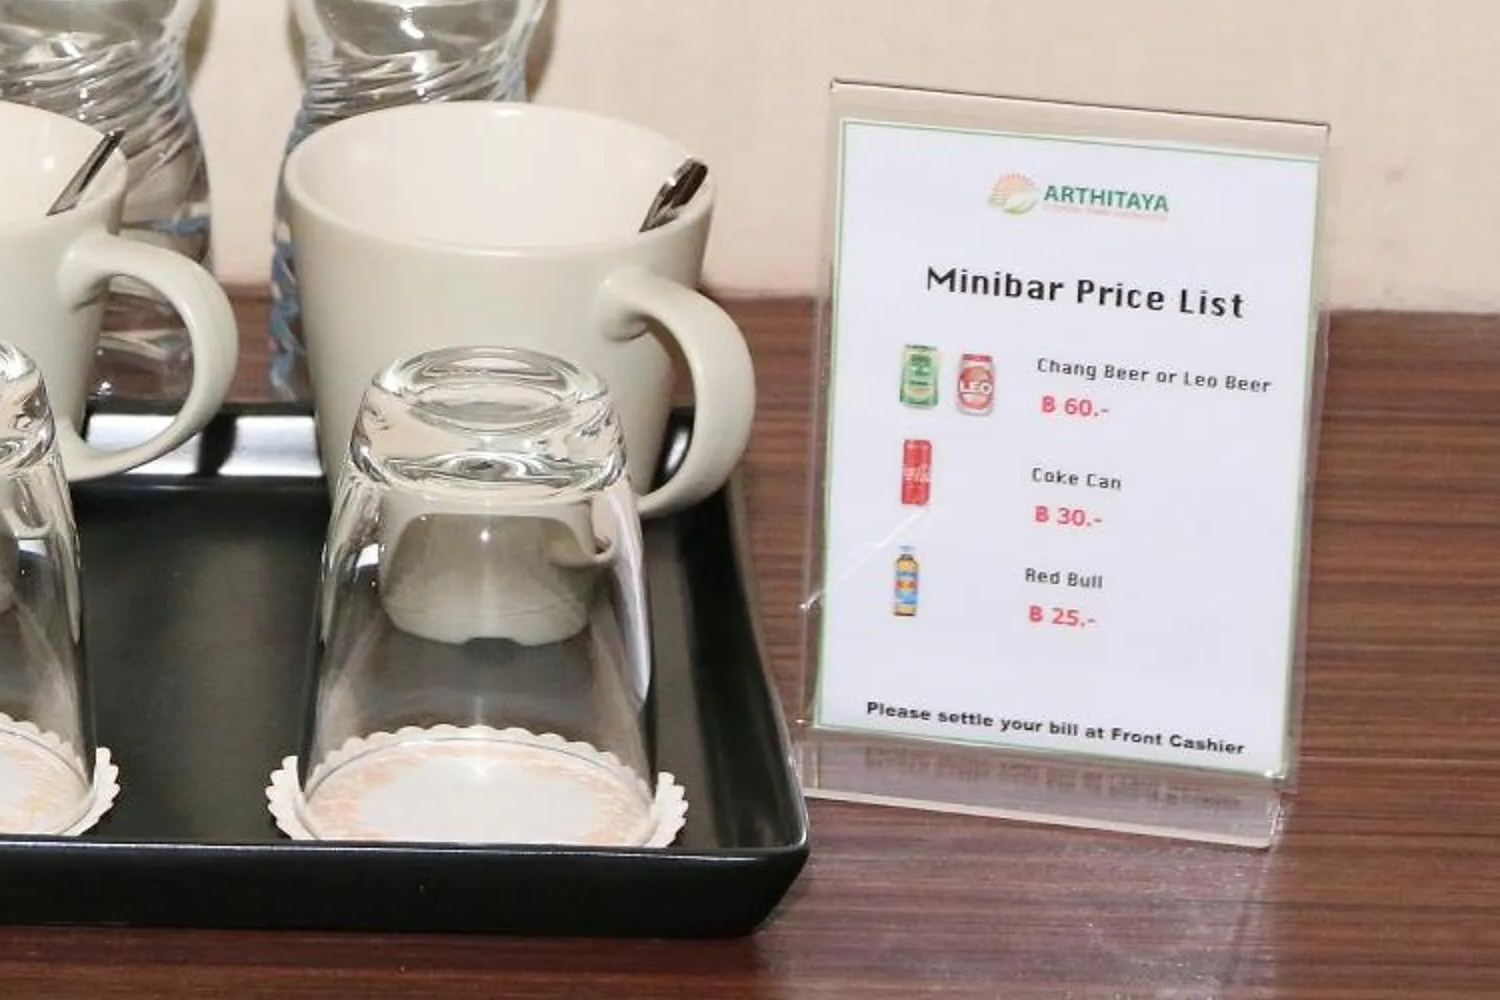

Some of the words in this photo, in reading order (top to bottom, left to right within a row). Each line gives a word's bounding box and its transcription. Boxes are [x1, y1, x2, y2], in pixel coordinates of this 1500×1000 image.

[1043, 184, 1170, 213] ARTHITAYA
[926, 265, 1064, 302] Minibar
[1076, 278, 1165, 312] Price
[1178, 288, 1245, 319] List
[1036, 356, 1098, 381] Chang
[1103, 363, 1151, 382] Beer
[1155, 370, 1178, 384] or
[1183, 371, 1218, 389] Leo
[1225, 375, 1273, 393] Beer
[1063, 397, 1109, 417] 60.-
[1031, 466, 1079, 486] Coke
[1086, 472, 1122, 491] Can
[1056, 506, 1103, 527] 30.-
[1024, 567, 1061, 585] Red
[1067, 571, 1103, 589] Bull
[1051, 606, 1098, 628] 25.-
[866, 701, 932, 721] Please
[938, 711, 994, 727] settle
[1000, 718, 1043, 732] your
[1049, 720, 1079, 737] bill
[1084, 727, 1105, 739] at
[1111, 727, 1163, 746] Front
[1168, 733, 1247, 755] Cashier
